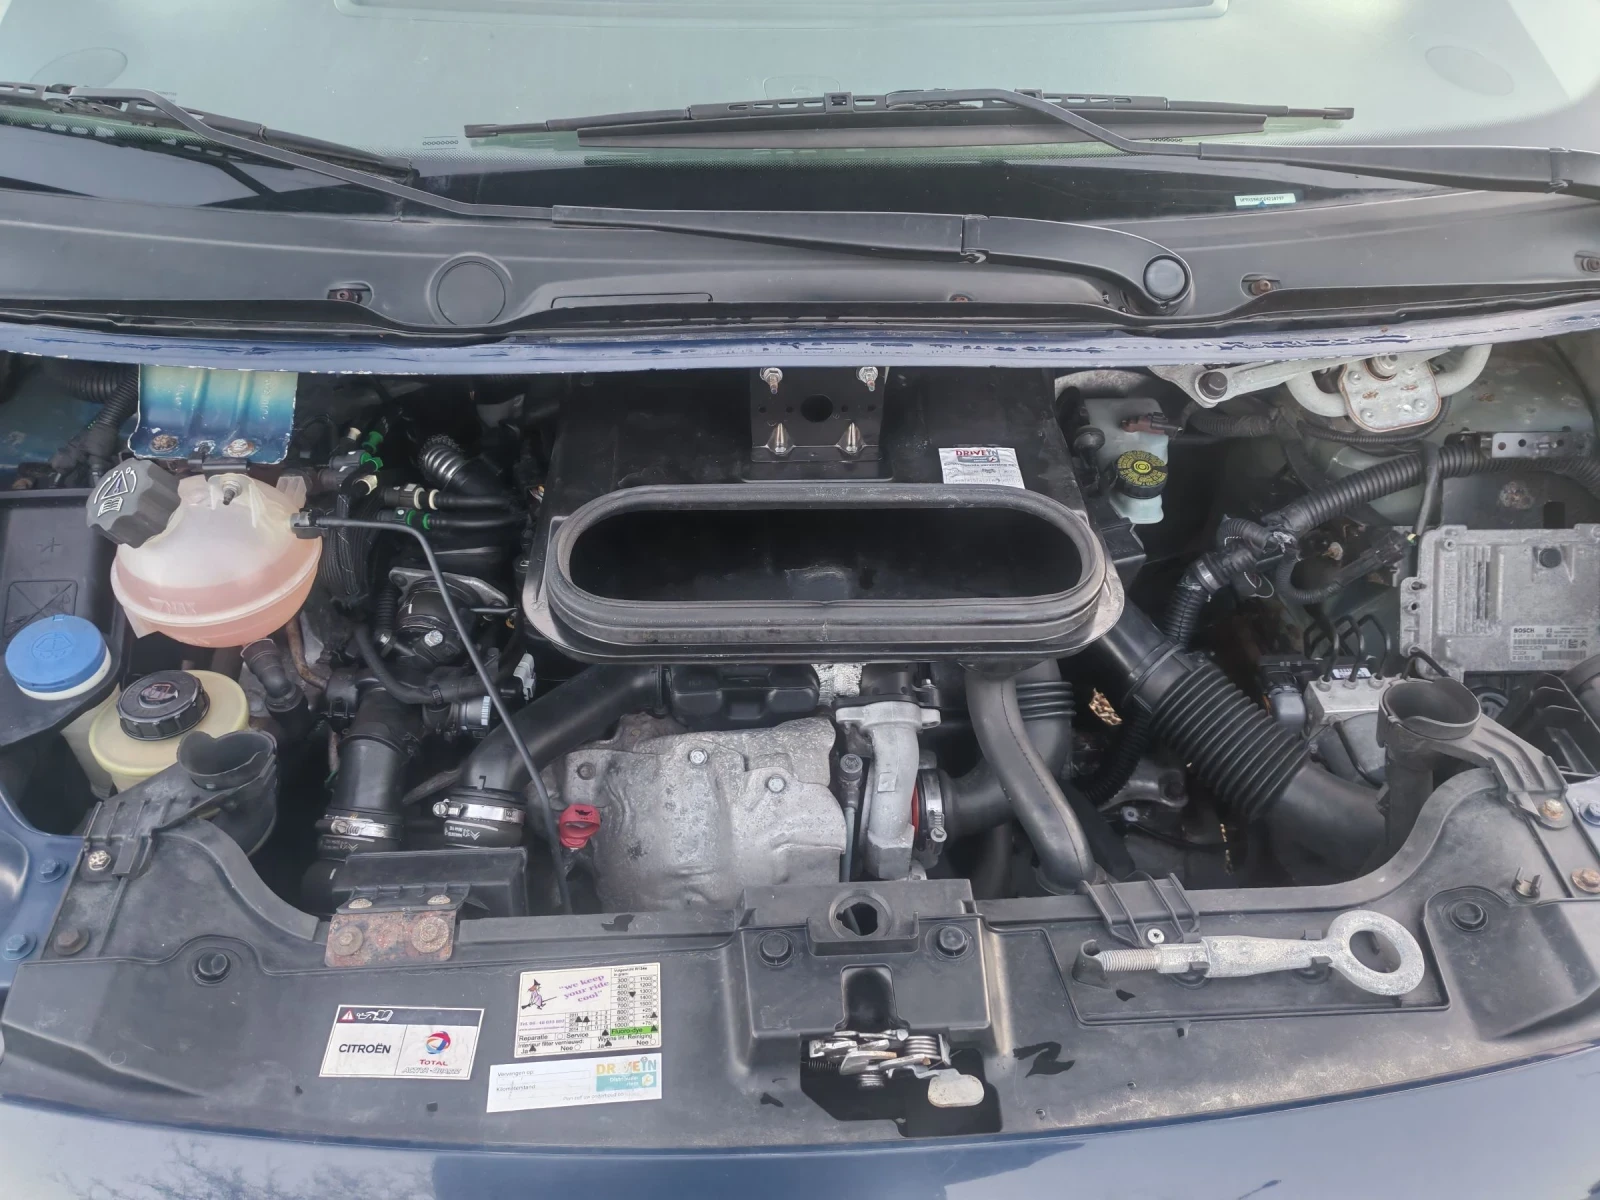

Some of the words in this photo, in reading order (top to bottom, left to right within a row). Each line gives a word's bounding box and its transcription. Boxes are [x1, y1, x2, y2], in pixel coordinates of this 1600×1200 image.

[580, 975, 605, 984] keep
[564, 987, 587, 999] your
[588, 981, 609, 991] ride
[519, 1034, 548, 1042] Reparatie
[338, 1043, 391, 1054] CITROËN
